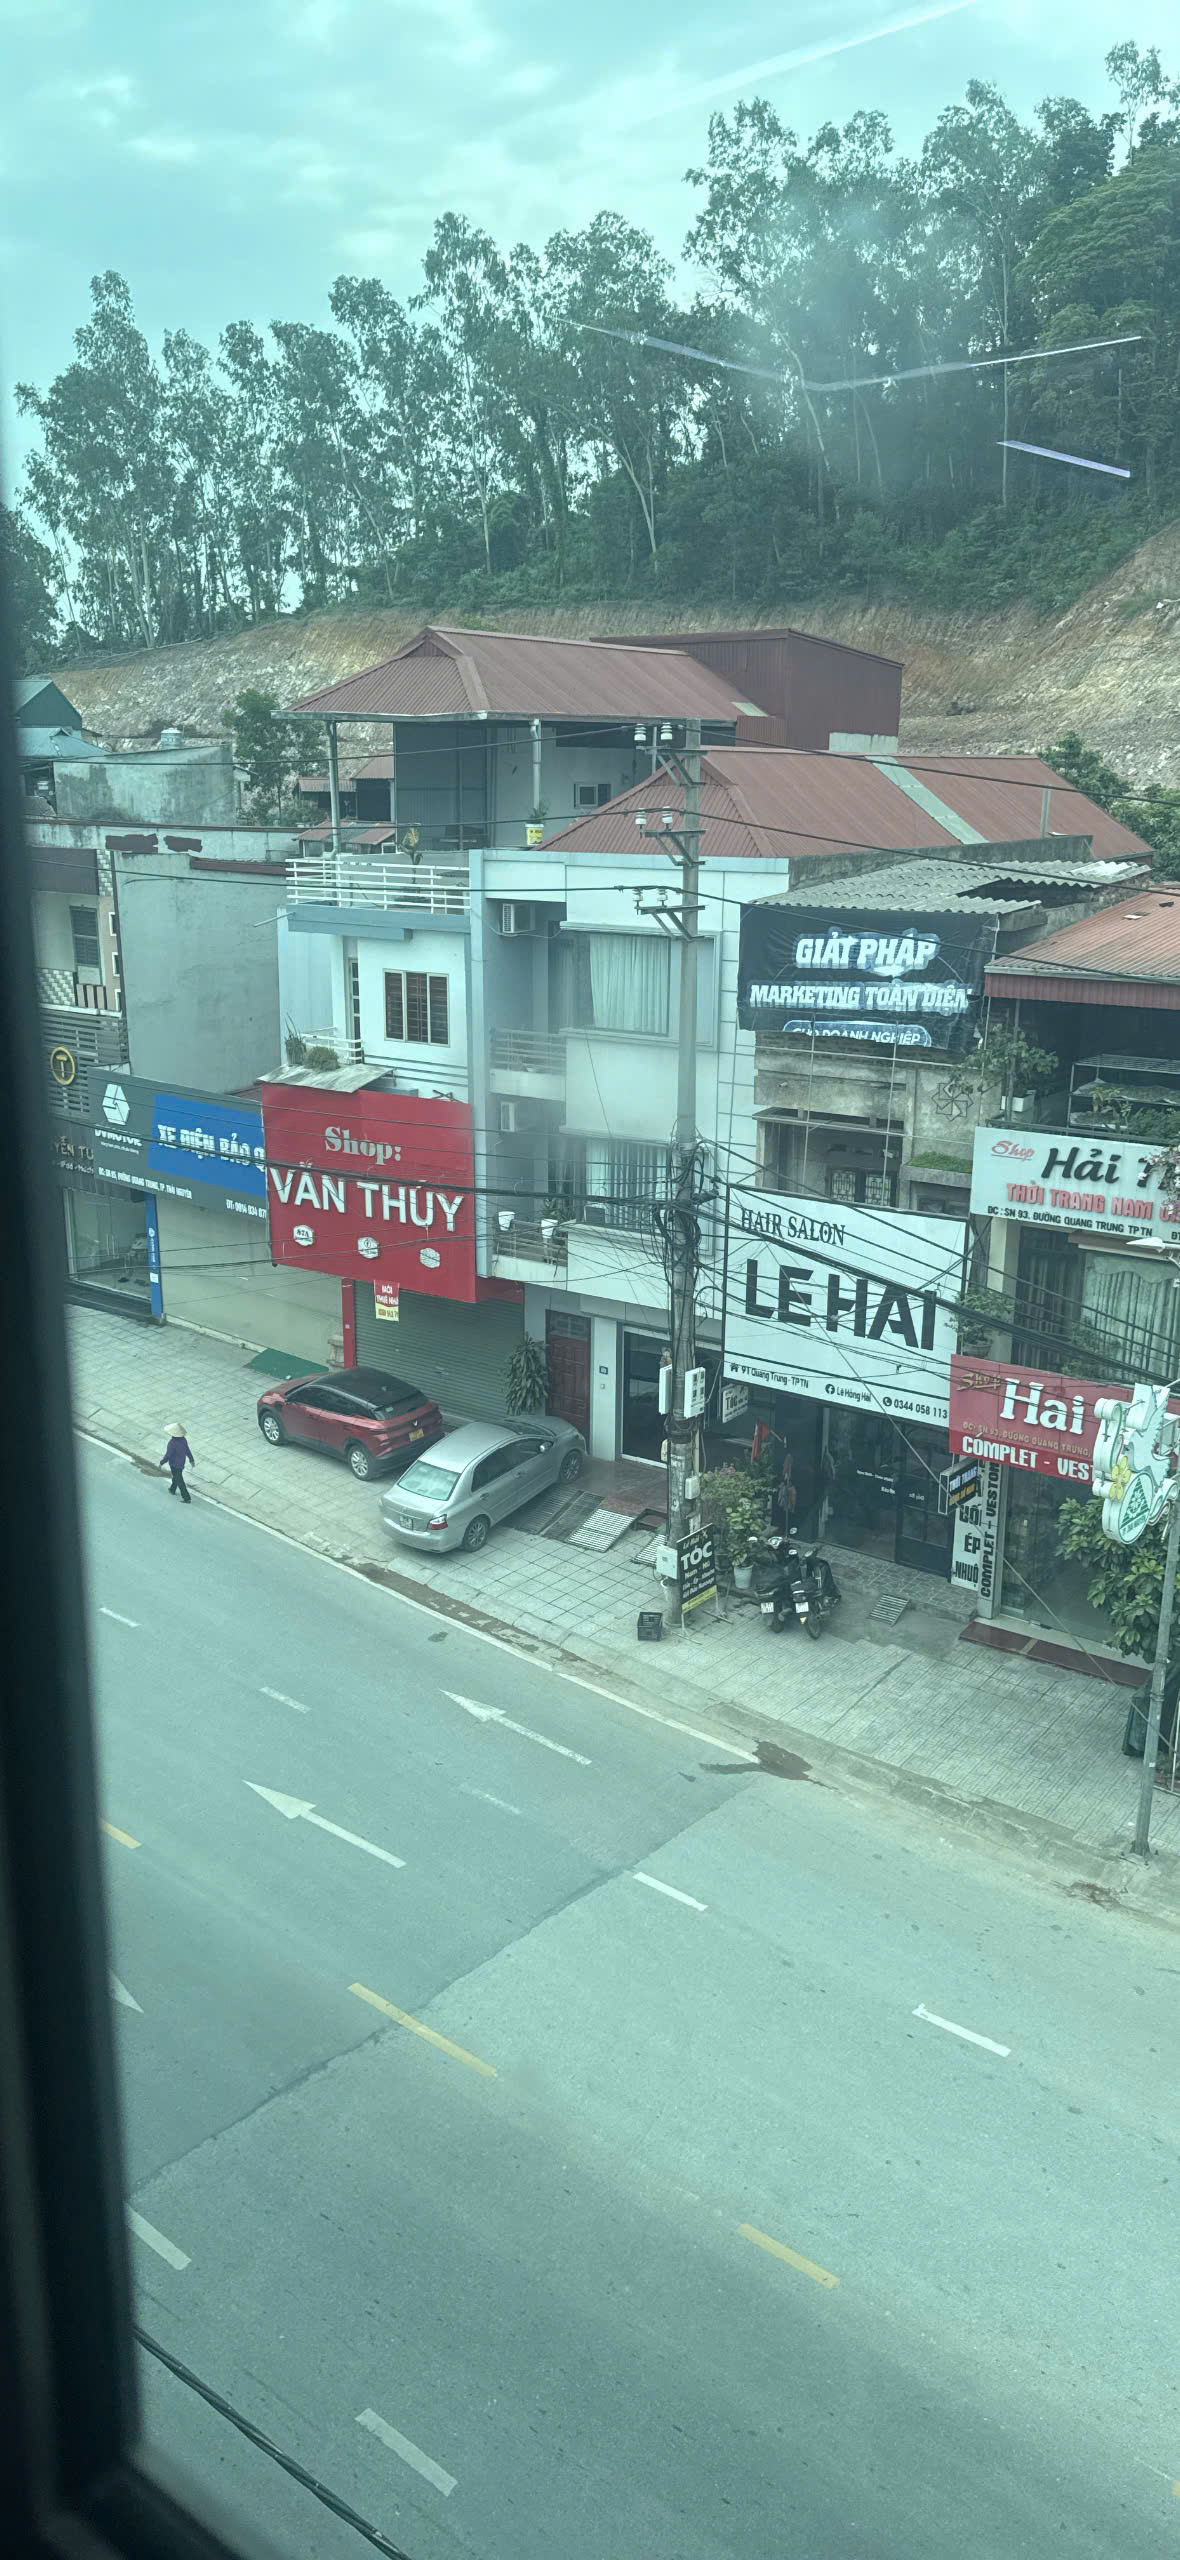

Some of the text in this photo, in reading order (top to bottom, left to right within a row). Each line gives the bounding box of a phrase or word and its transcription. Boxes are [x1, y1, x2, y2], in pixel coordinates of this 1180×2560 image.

[857, 932, 936, 967] PHÁP
[750, 984, 860, 1007] MARKETING
[324, 1126, 402, 1166] Shop:
[1041, 1147, 1122, 1184] Hải
[1004, 1207, 1016, 1218] SN
[1064, 1216, 1093, 1229] QUANG
[1096, 1220, 1125, 1233] TRUNG
[1050, 1189, 1106, 1214] TRANG
[1111, 1196, 1154, 1221] NAM
[741, 1207, 846, 1246] HAIR SALON
[745, 1258, 937, 1351] LE HAI
[751, 1367, 770, 1381] Quang
[771, 1371, 788, 1385] Trung
[893, 1399, 948, 1419] 0344 058 113
[1000, 1377, 1087, 1435] Hai
[1057, 1457, 1095, 1481] VES
[680, 1541, 713, 1571] TÓC
[964, 1532, 981, 1554] ÉP
[981, 1531, 995, 1598] COMPLET
